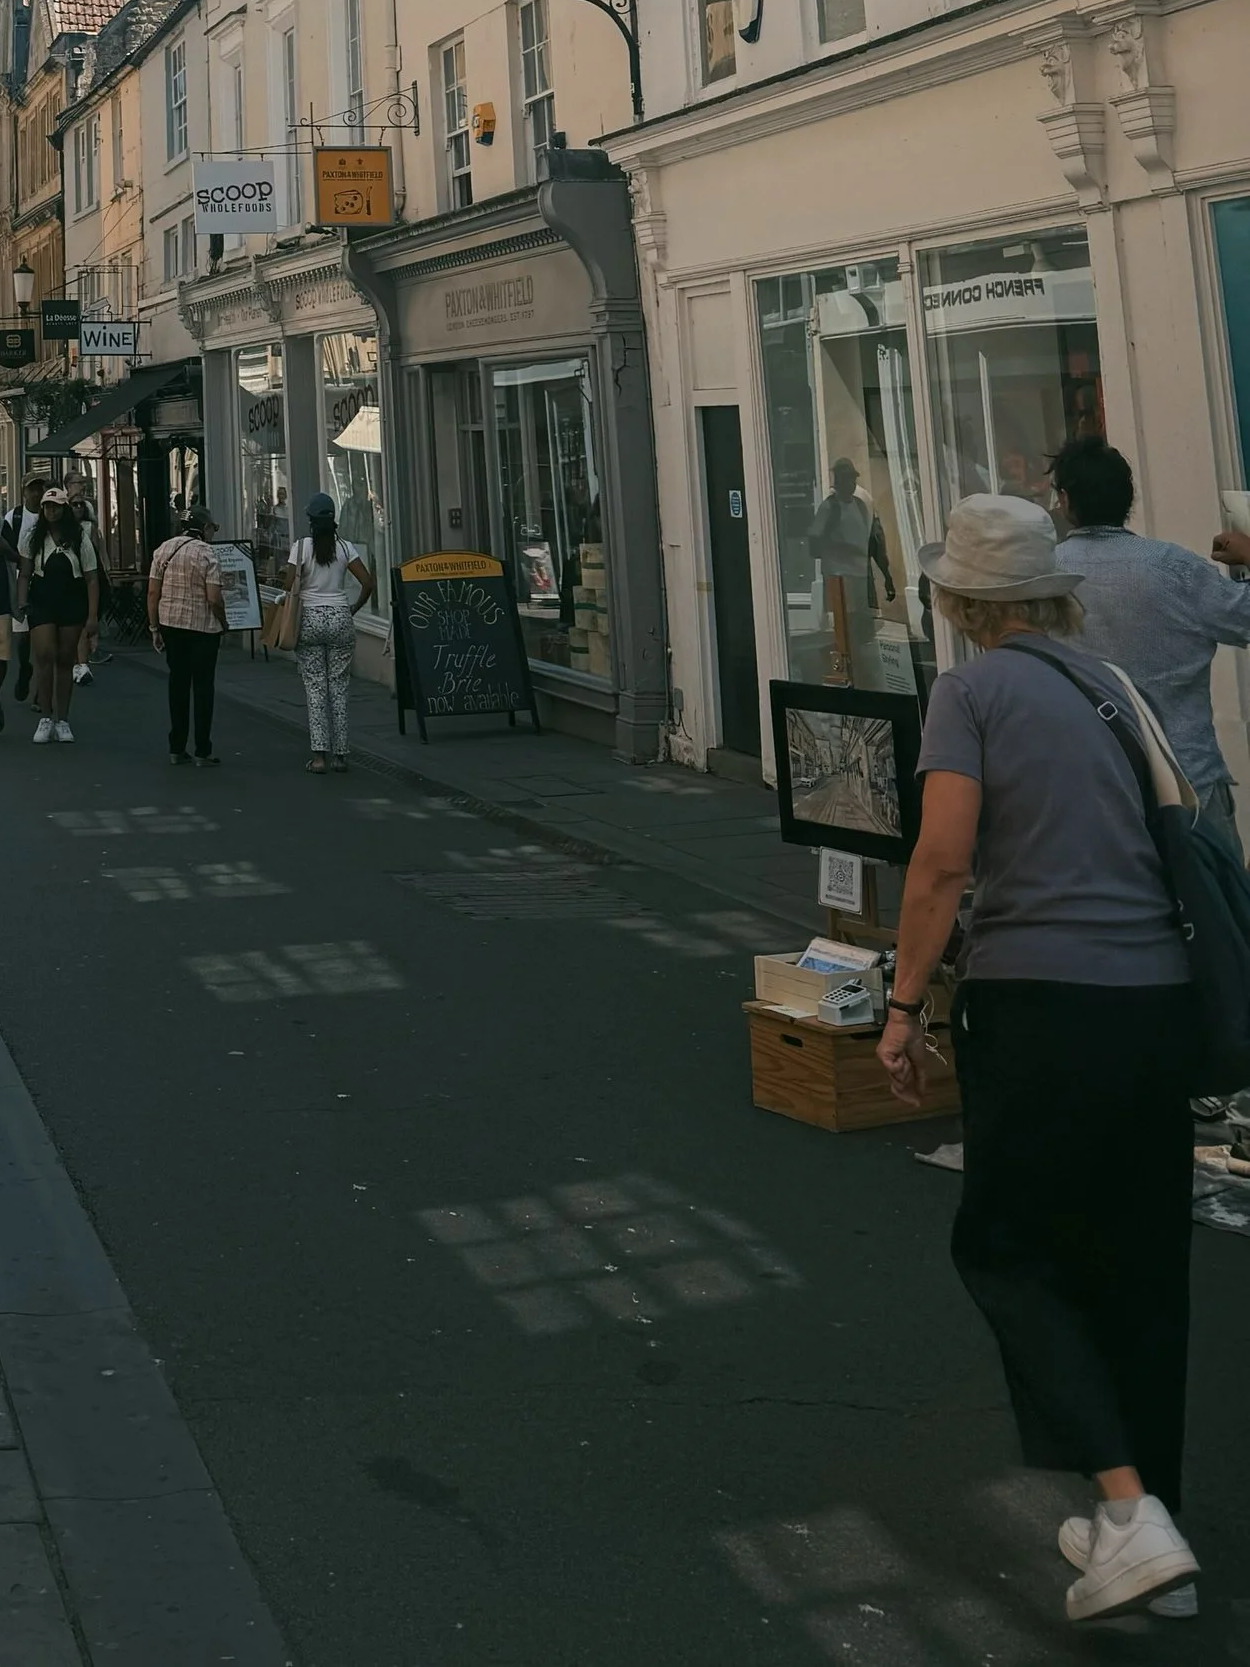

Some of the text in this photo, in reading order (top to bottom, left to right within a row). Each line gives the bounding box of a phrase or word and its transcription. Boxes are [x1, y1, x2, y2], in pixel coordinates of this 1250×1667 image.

[202, 203, 272, 213] WHOLEFOODS
[408, 580, 505, 629] OUR FAMOUS
[437, 609, 472, 626] SHOP
[432, 644, 497, 678] Truffle
[437, 671, 483, 695] Brie
[427, 681, 520, 714] now available
